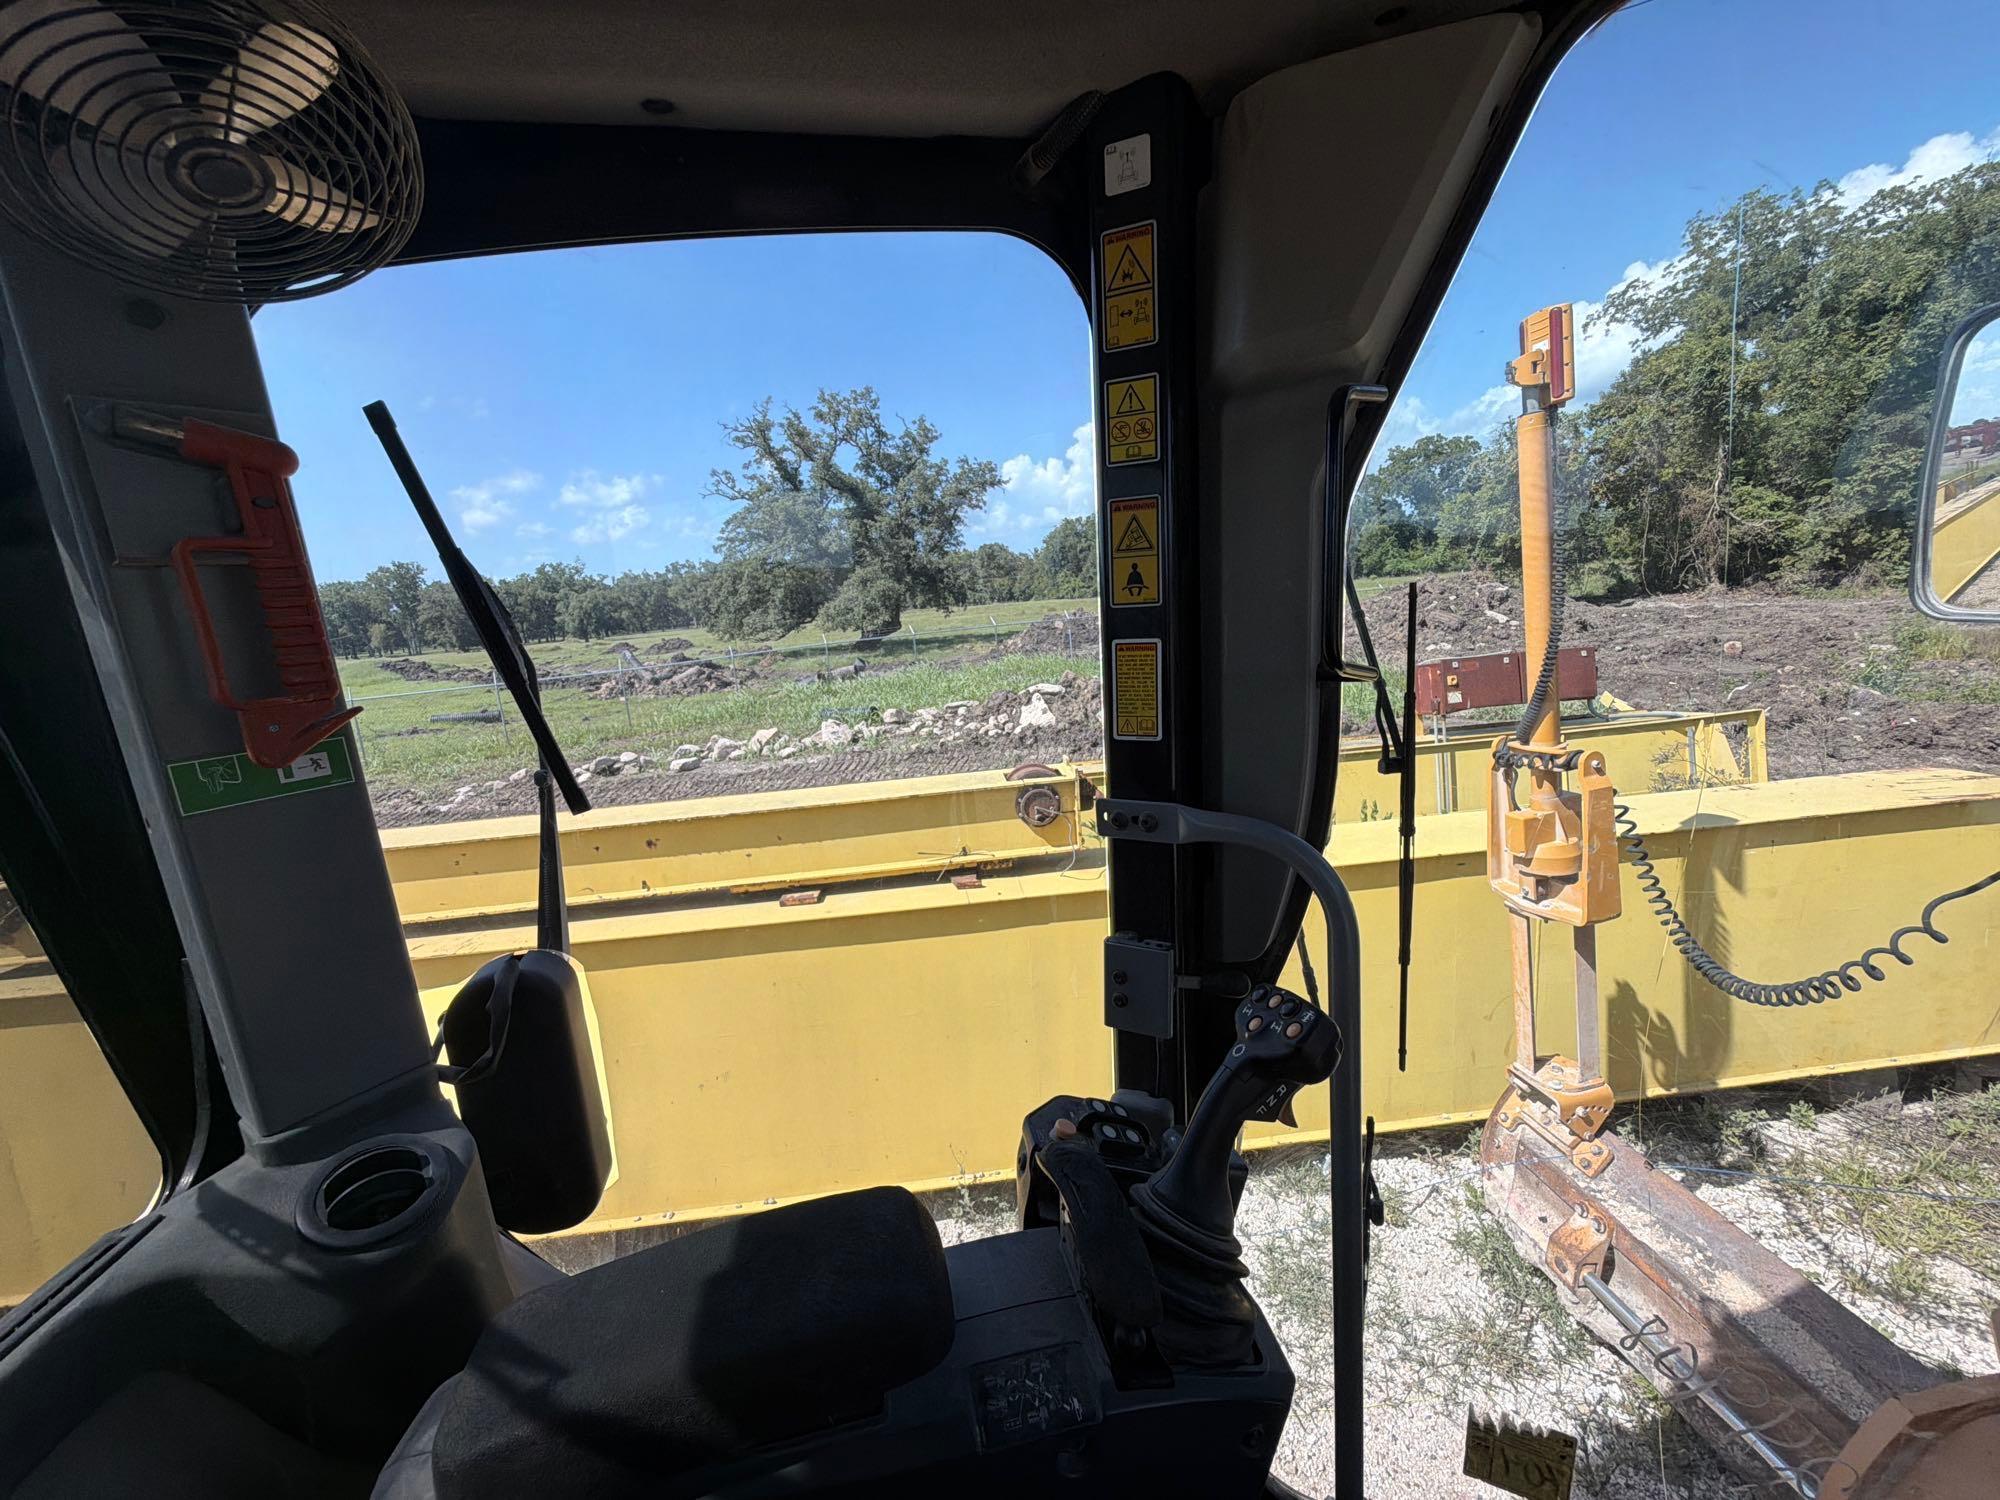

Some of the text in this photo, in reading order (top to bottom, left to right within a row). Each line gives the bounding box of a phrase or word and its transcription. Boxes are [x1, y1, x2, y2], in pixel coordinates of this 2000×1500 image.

[1115, 227, 1150, 243] WARNING
[1121, 502, 1155, 511] WARNING
[1276, 1084, 1287, 1097] R
[1266, 1094, 1278, 1107] N
[1256, 1105, 1268, 1115] F
